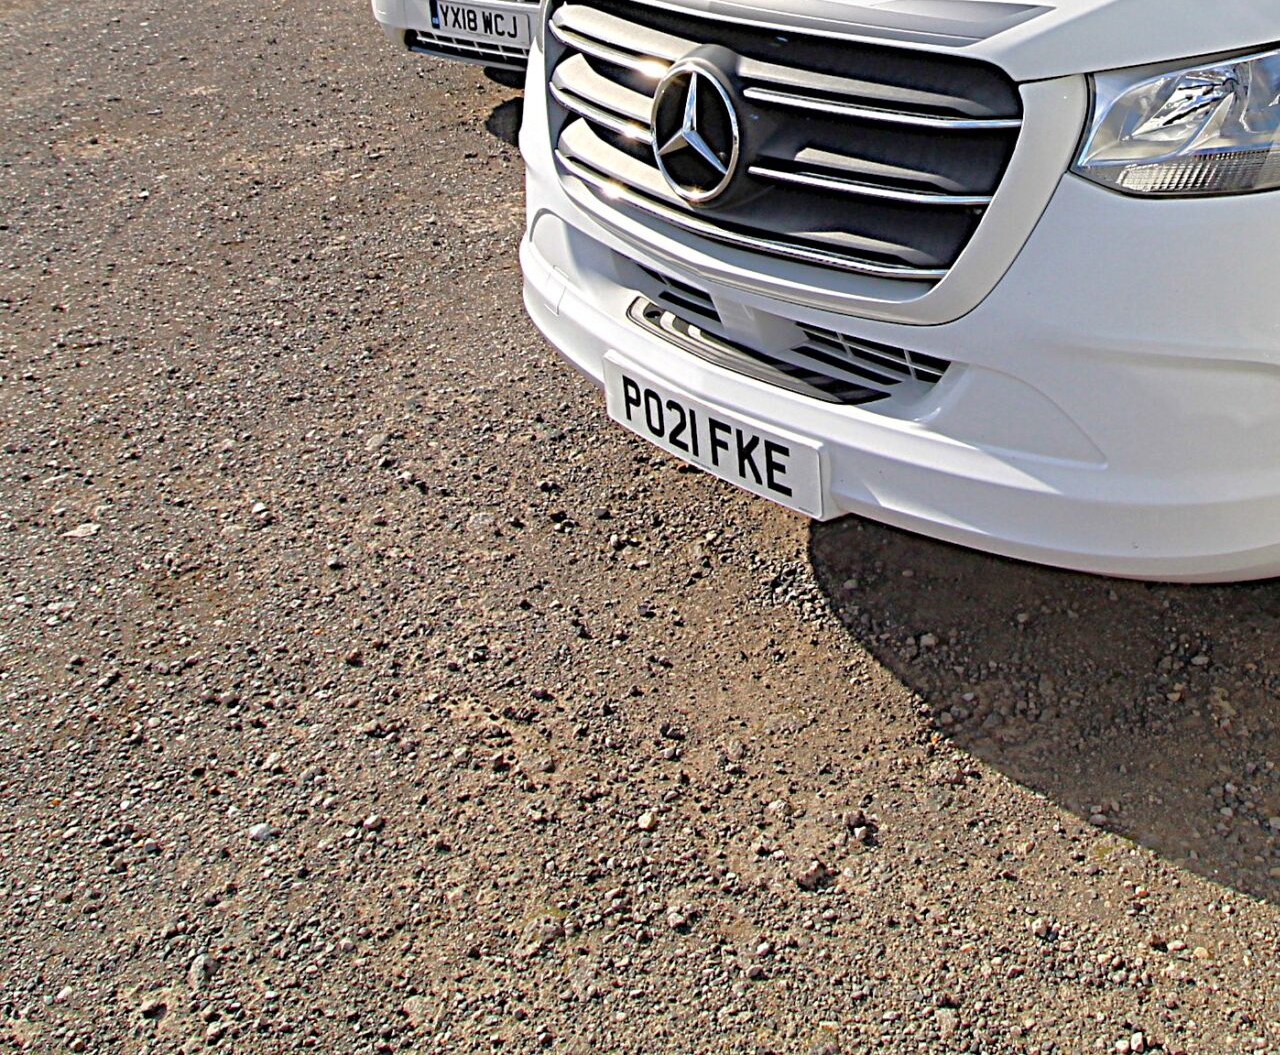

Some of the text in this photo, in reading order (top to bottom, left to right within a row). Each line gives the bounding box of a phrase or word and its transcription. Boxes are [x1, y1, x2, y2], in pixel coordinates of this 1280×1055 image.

[438, 3, 518, 39] YX18 WCJ
[622, 374, 793, 498] PO21 FKE
